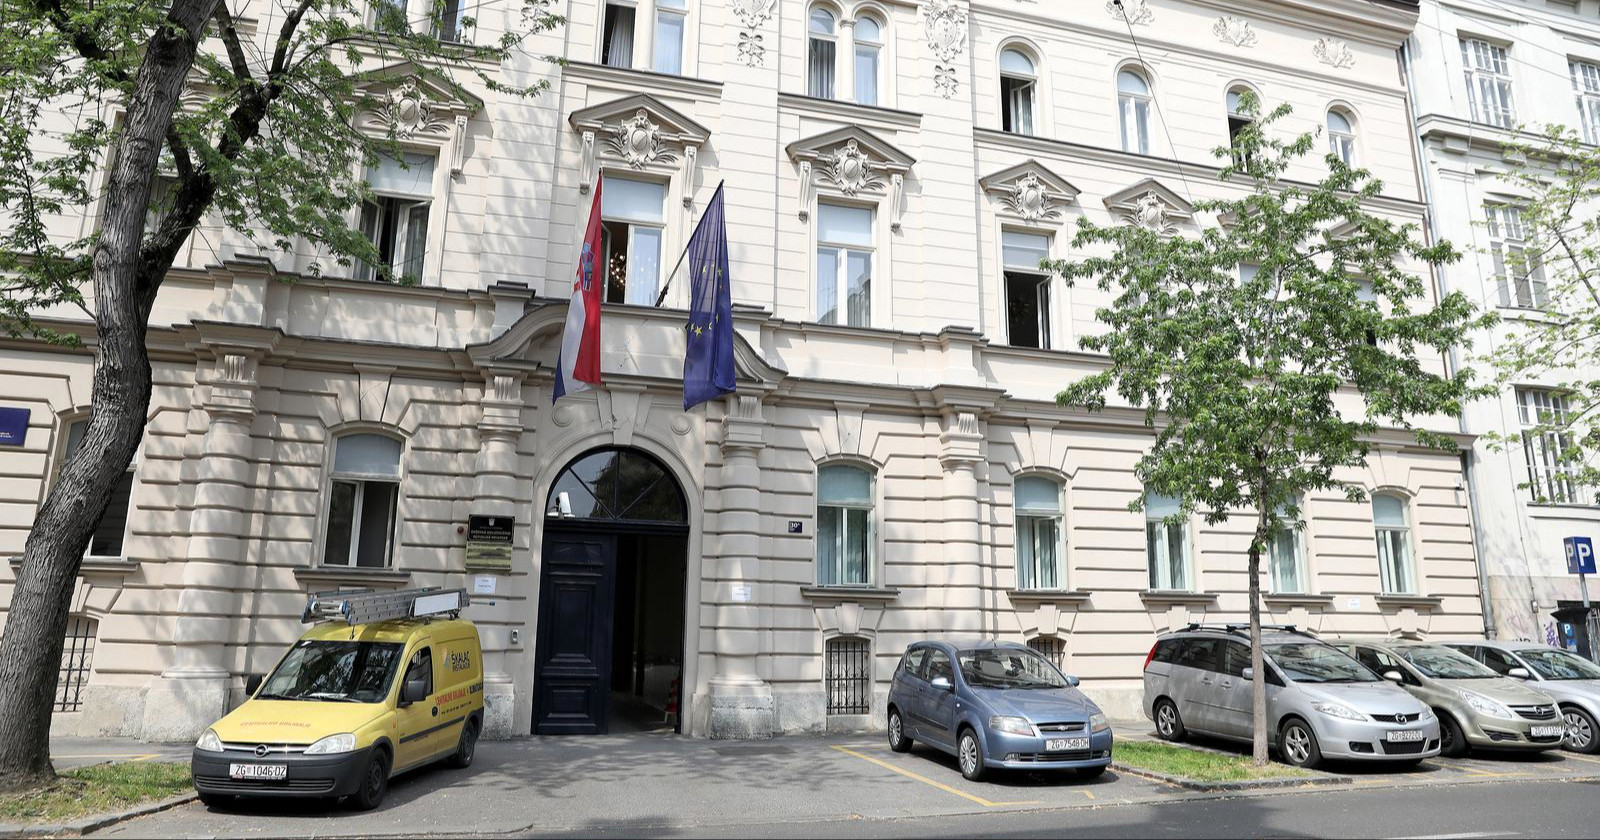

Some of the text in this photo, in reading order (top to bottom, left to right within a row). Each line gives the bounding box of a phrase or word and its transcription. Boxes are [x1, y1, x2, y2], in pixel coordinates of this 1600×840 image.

[1566, 544, 1574, 568] P
[1577, 543, 1590, 566] P
[1564, 624, 1570, 635] P
[1052, 739, 1060, 749] ZG
[236, 765, 246, 776] ZG
